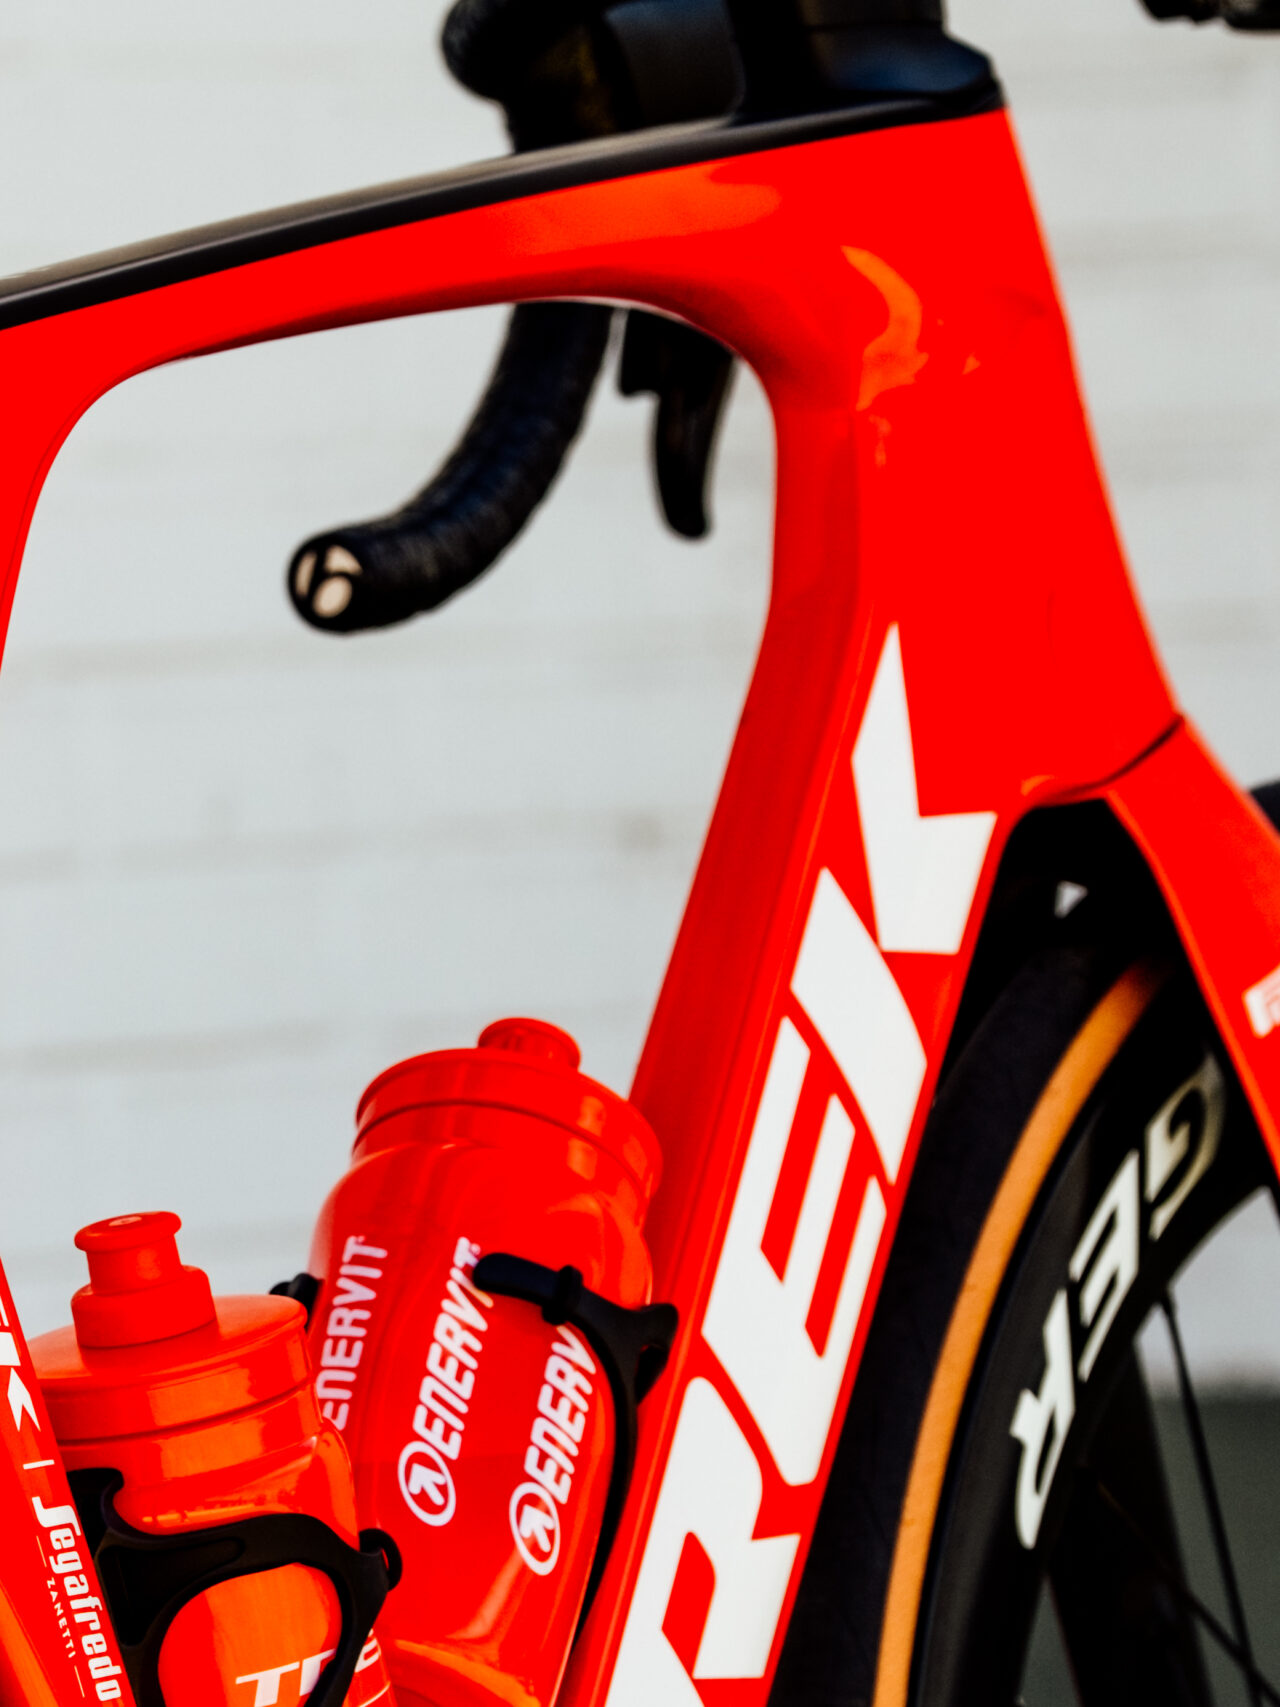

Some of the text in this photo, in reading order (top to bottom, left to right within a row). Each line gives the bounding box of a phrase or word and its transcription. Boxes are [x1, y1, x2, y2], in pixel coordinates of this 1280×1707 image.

[605, 622, 998, 1707] REK
[523, 1324, 596, 1505] ENERV
[31, 1496, 123, 1702] Segafredo
[46, 1577, 76, 1659] ZANETTI
